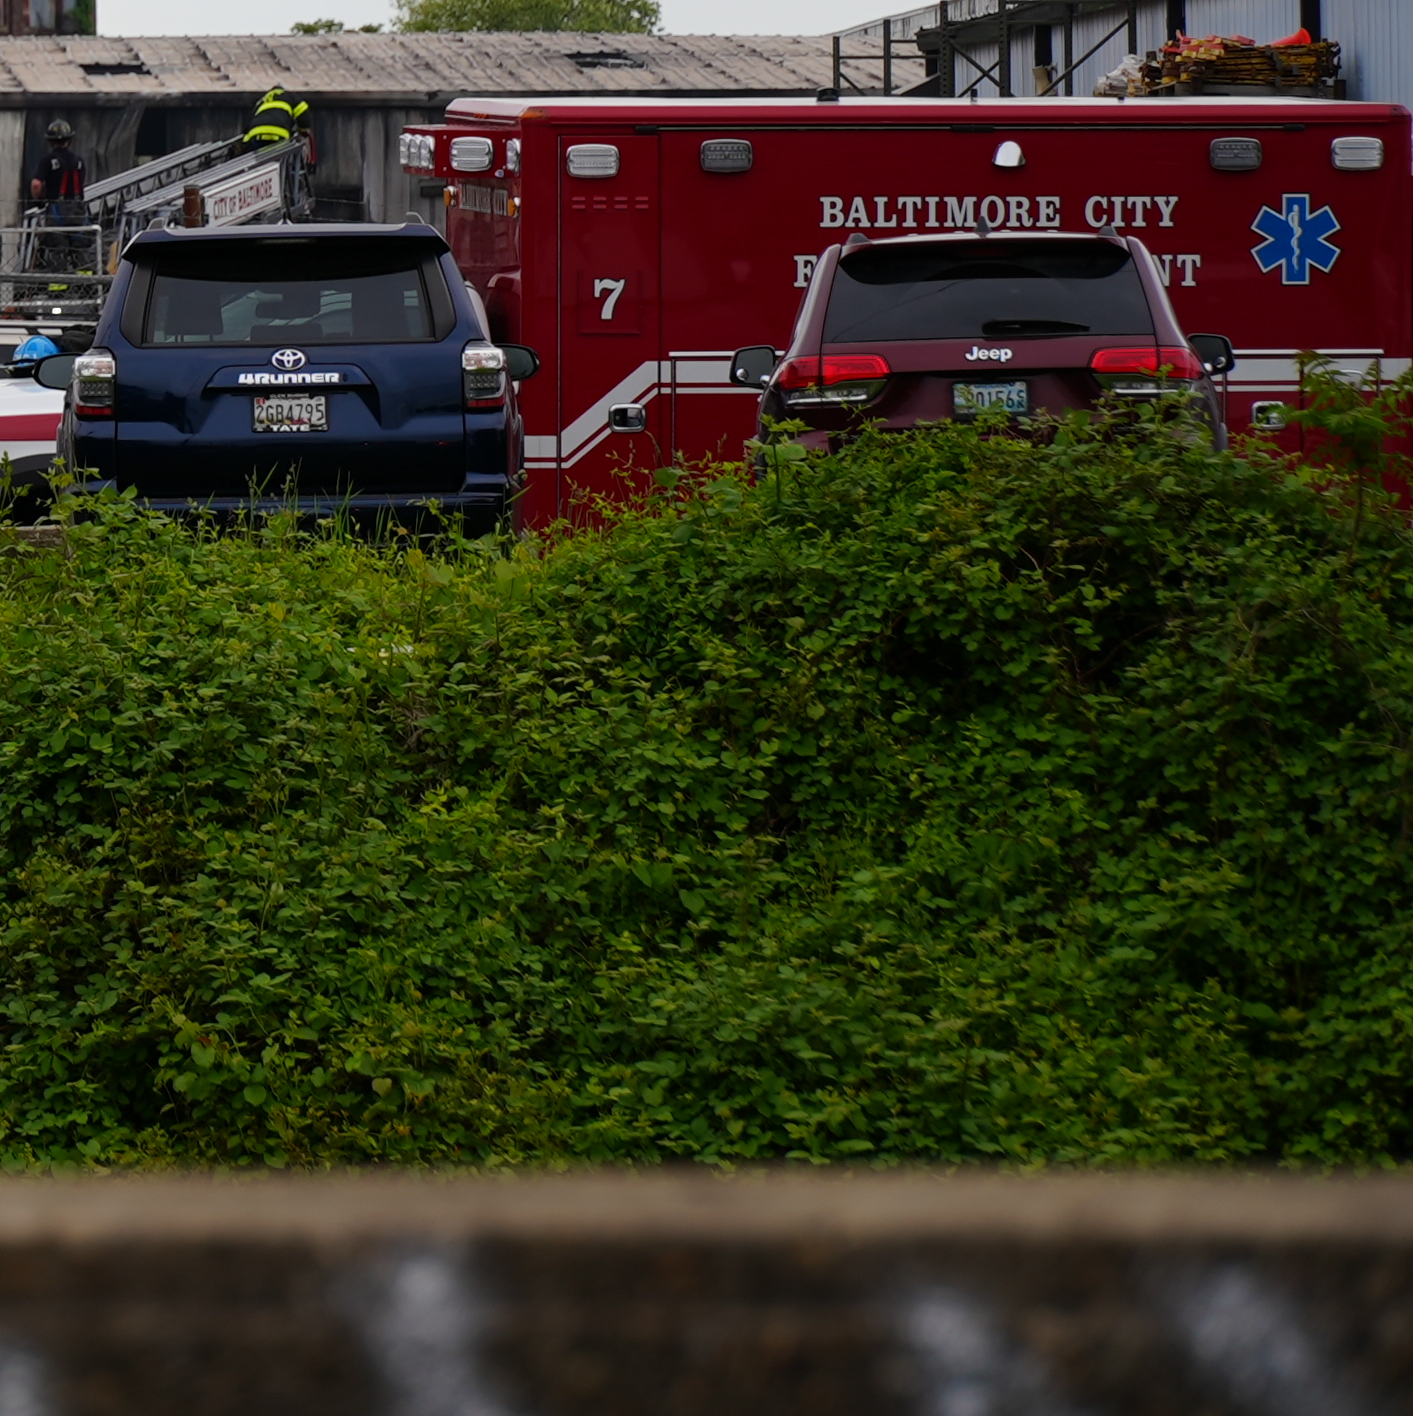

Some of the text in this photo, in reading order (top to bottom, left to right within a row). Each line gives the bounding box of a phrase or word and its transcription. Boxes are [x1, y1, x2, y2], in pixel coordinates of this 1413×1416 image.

[818, 195, 1179, 229] BALTIMORE CITY
[594, 278, 626, 320] 7
[965, 346, 1013, 362] Jeep
[256, 403, 325, 424] 2GB4795
[270, 424, 311, 432] TATE
